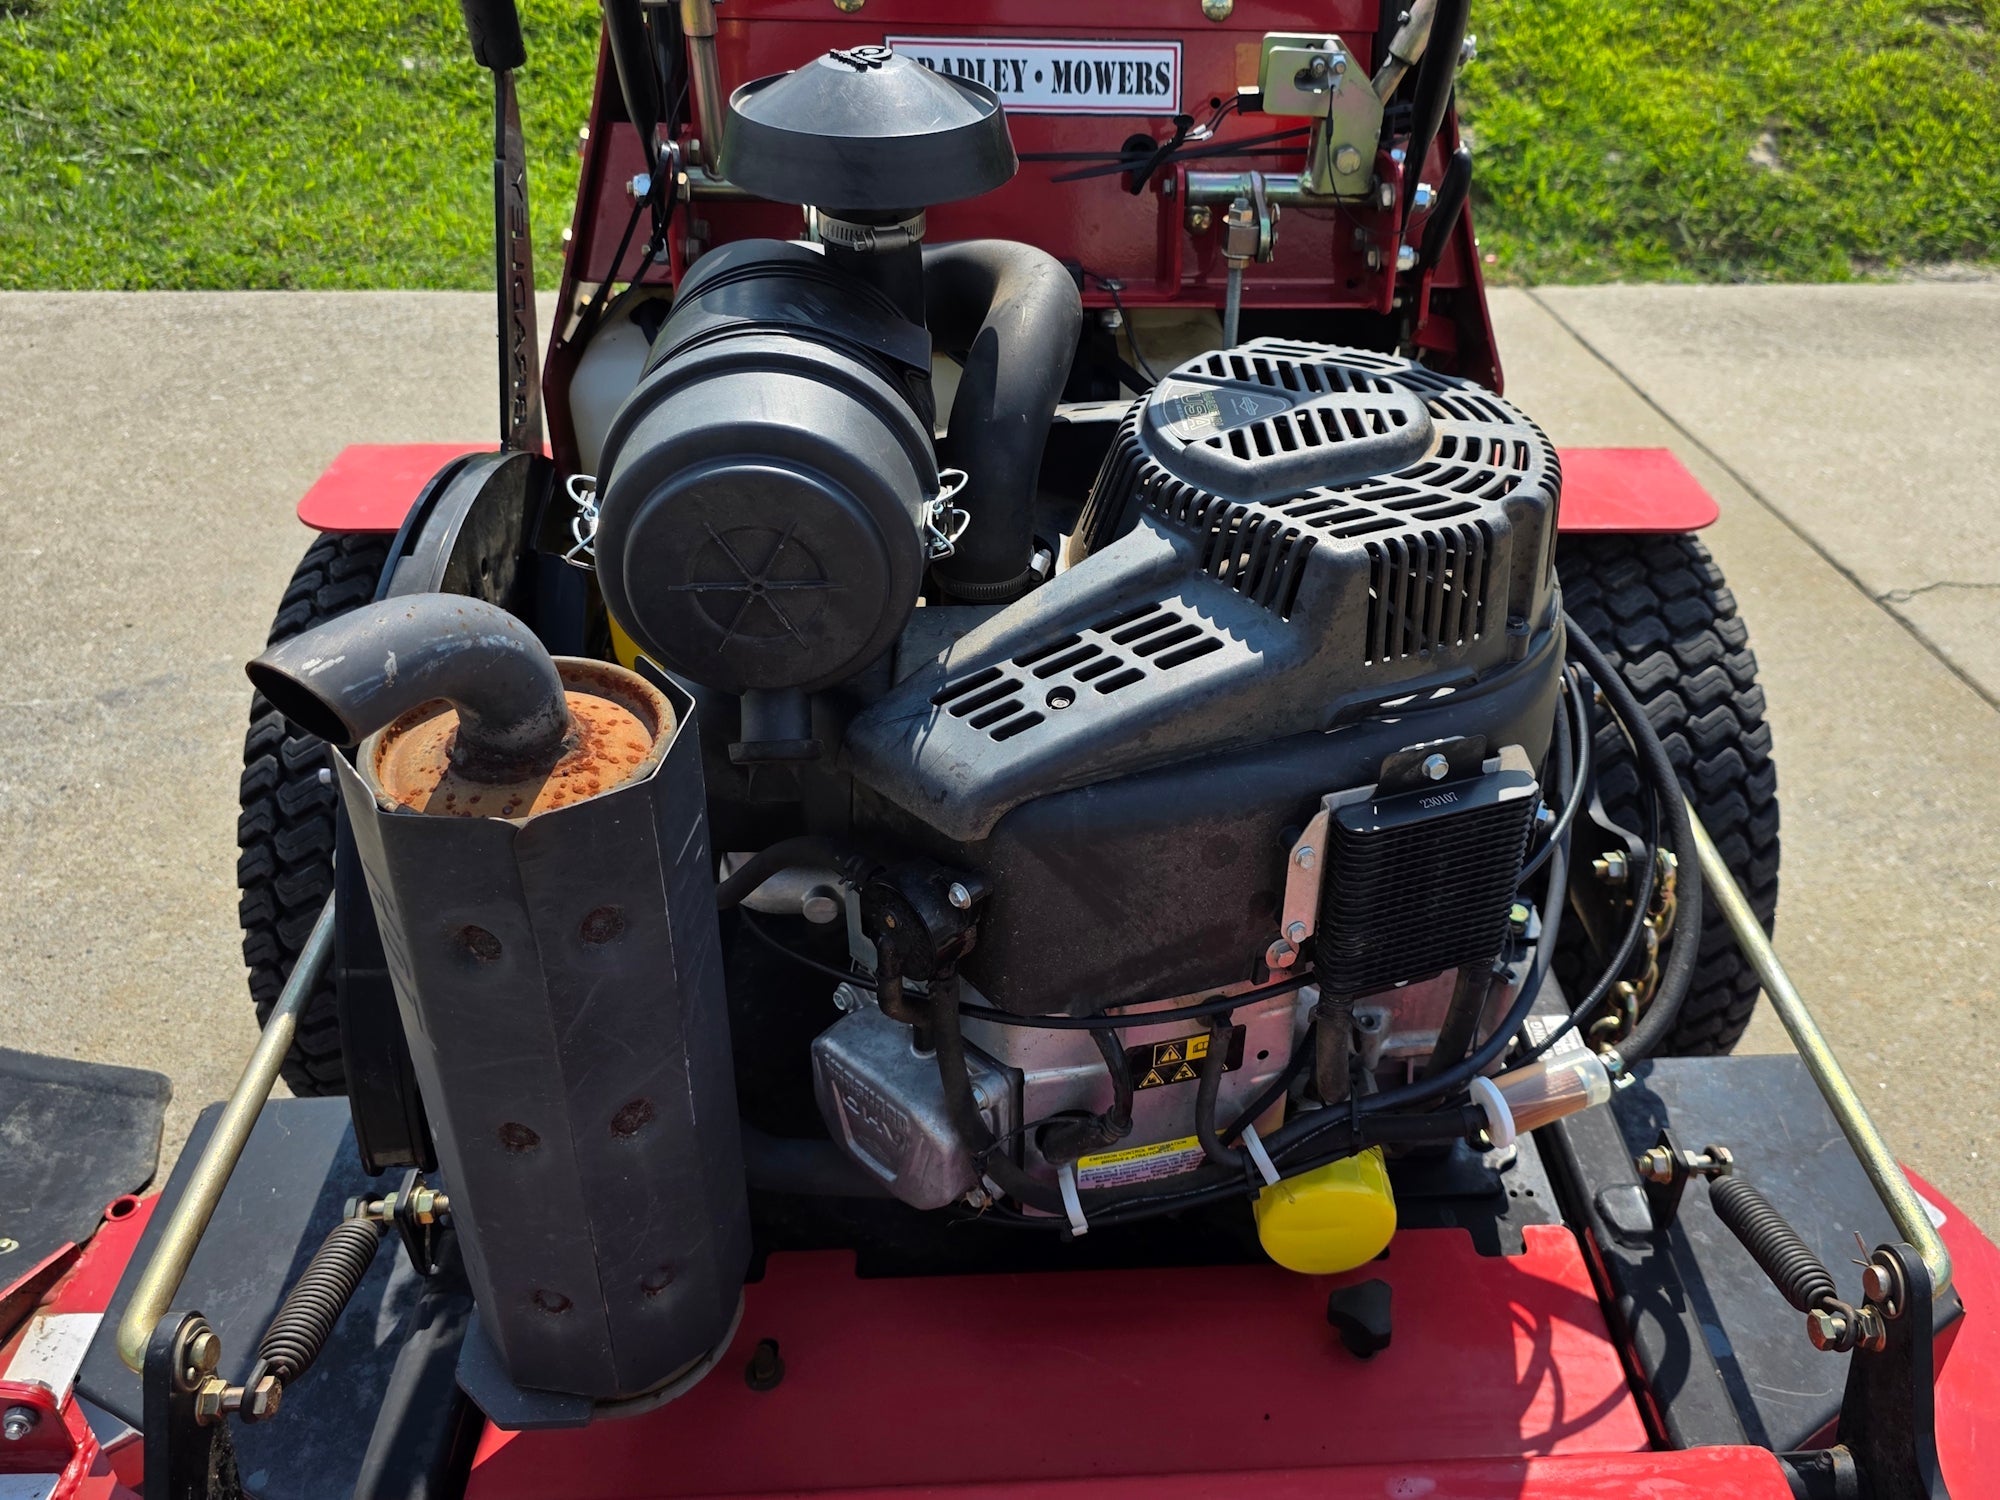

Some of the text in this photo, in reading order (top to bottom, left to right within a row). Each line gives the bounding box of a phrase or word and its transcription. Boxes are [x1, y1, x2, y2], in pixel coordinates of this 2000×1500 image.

[908, 57, 1028, 94] ADLEY
[1051, 59, 1170, 96] MOWERS
[1180, 393, 1212, 430] USA
[1419, 791, 1458, 809] 230107
